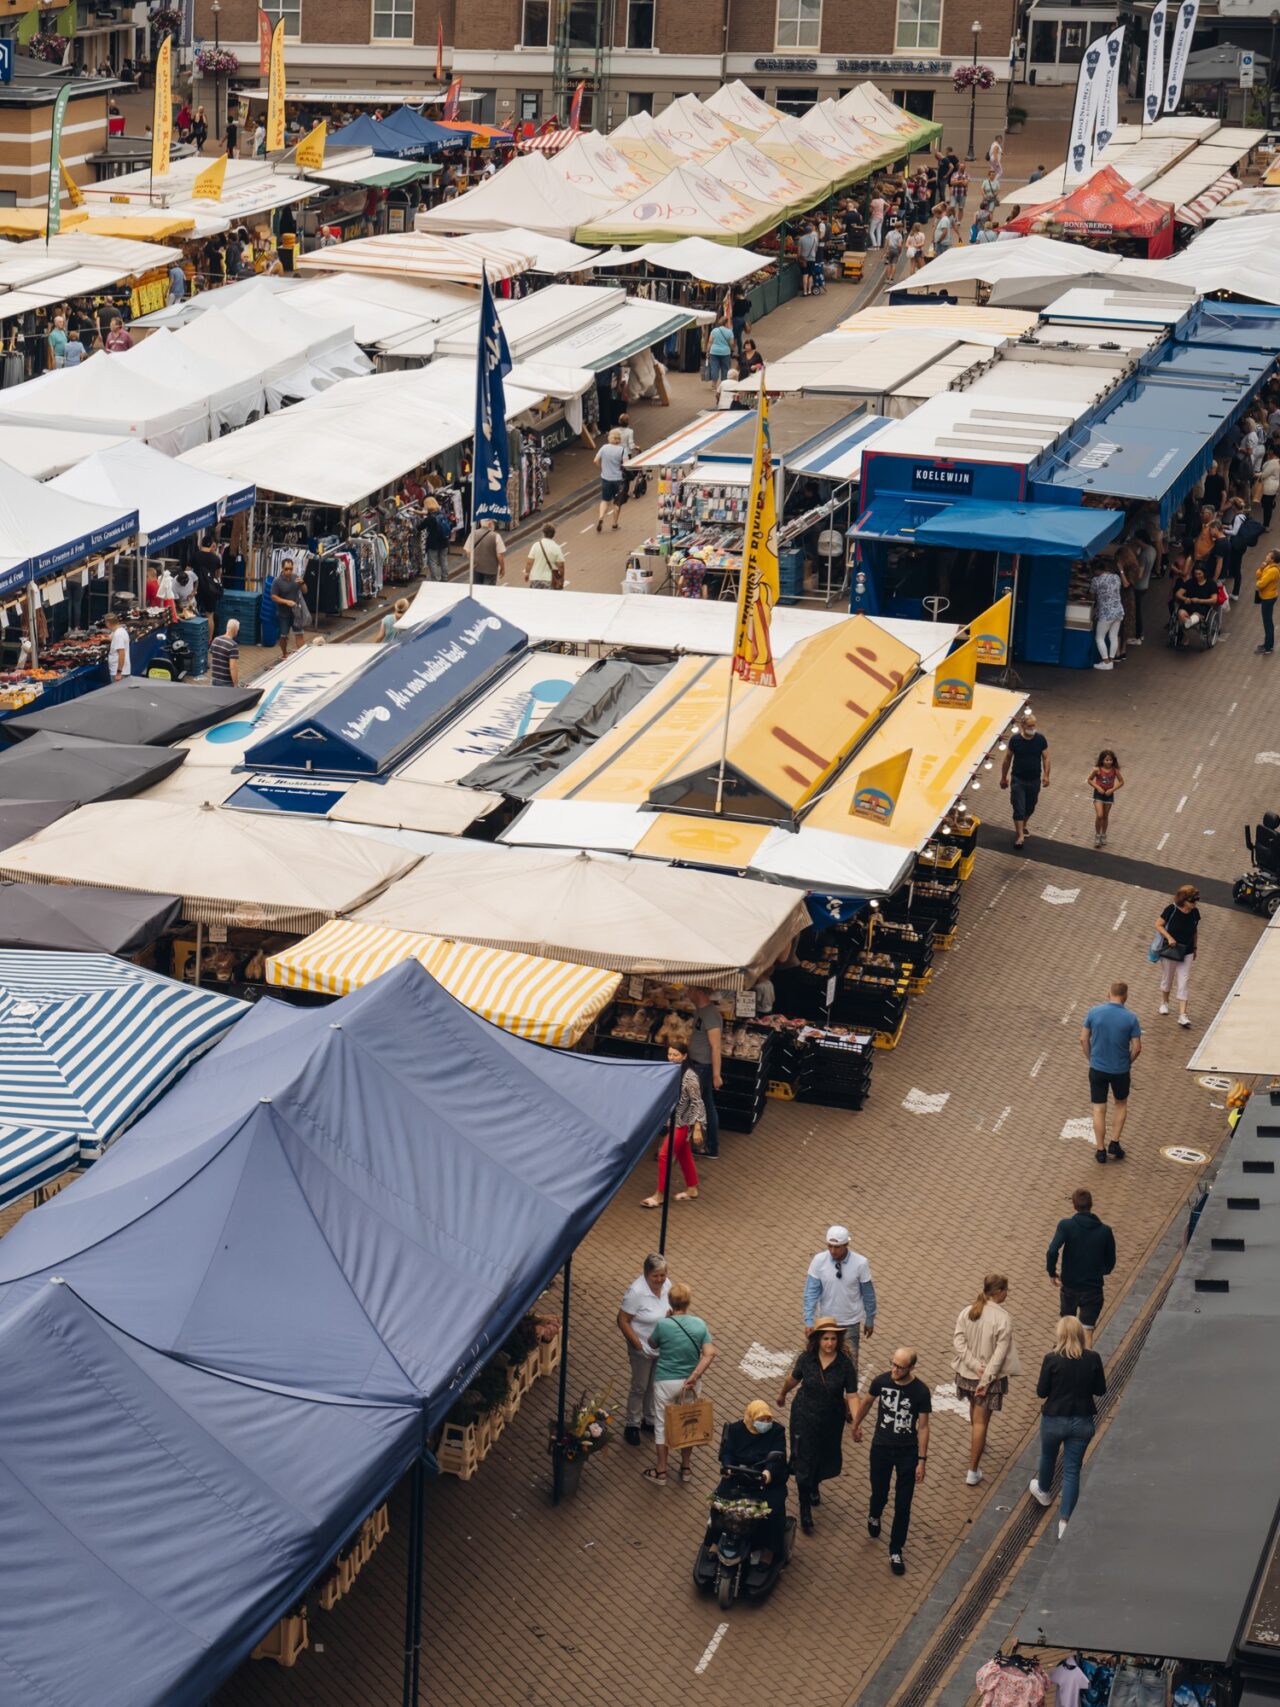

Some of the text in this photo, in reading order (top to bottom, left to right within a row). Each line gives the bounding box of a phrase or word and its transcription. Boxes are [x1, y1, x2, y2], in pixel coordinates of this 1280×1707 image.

[836, 59, 952, 74] RESTAURANT
[1064, 221, 1113, 230] BONENBERG'S
[916, 469, 970, 484] KOELEWIJN
